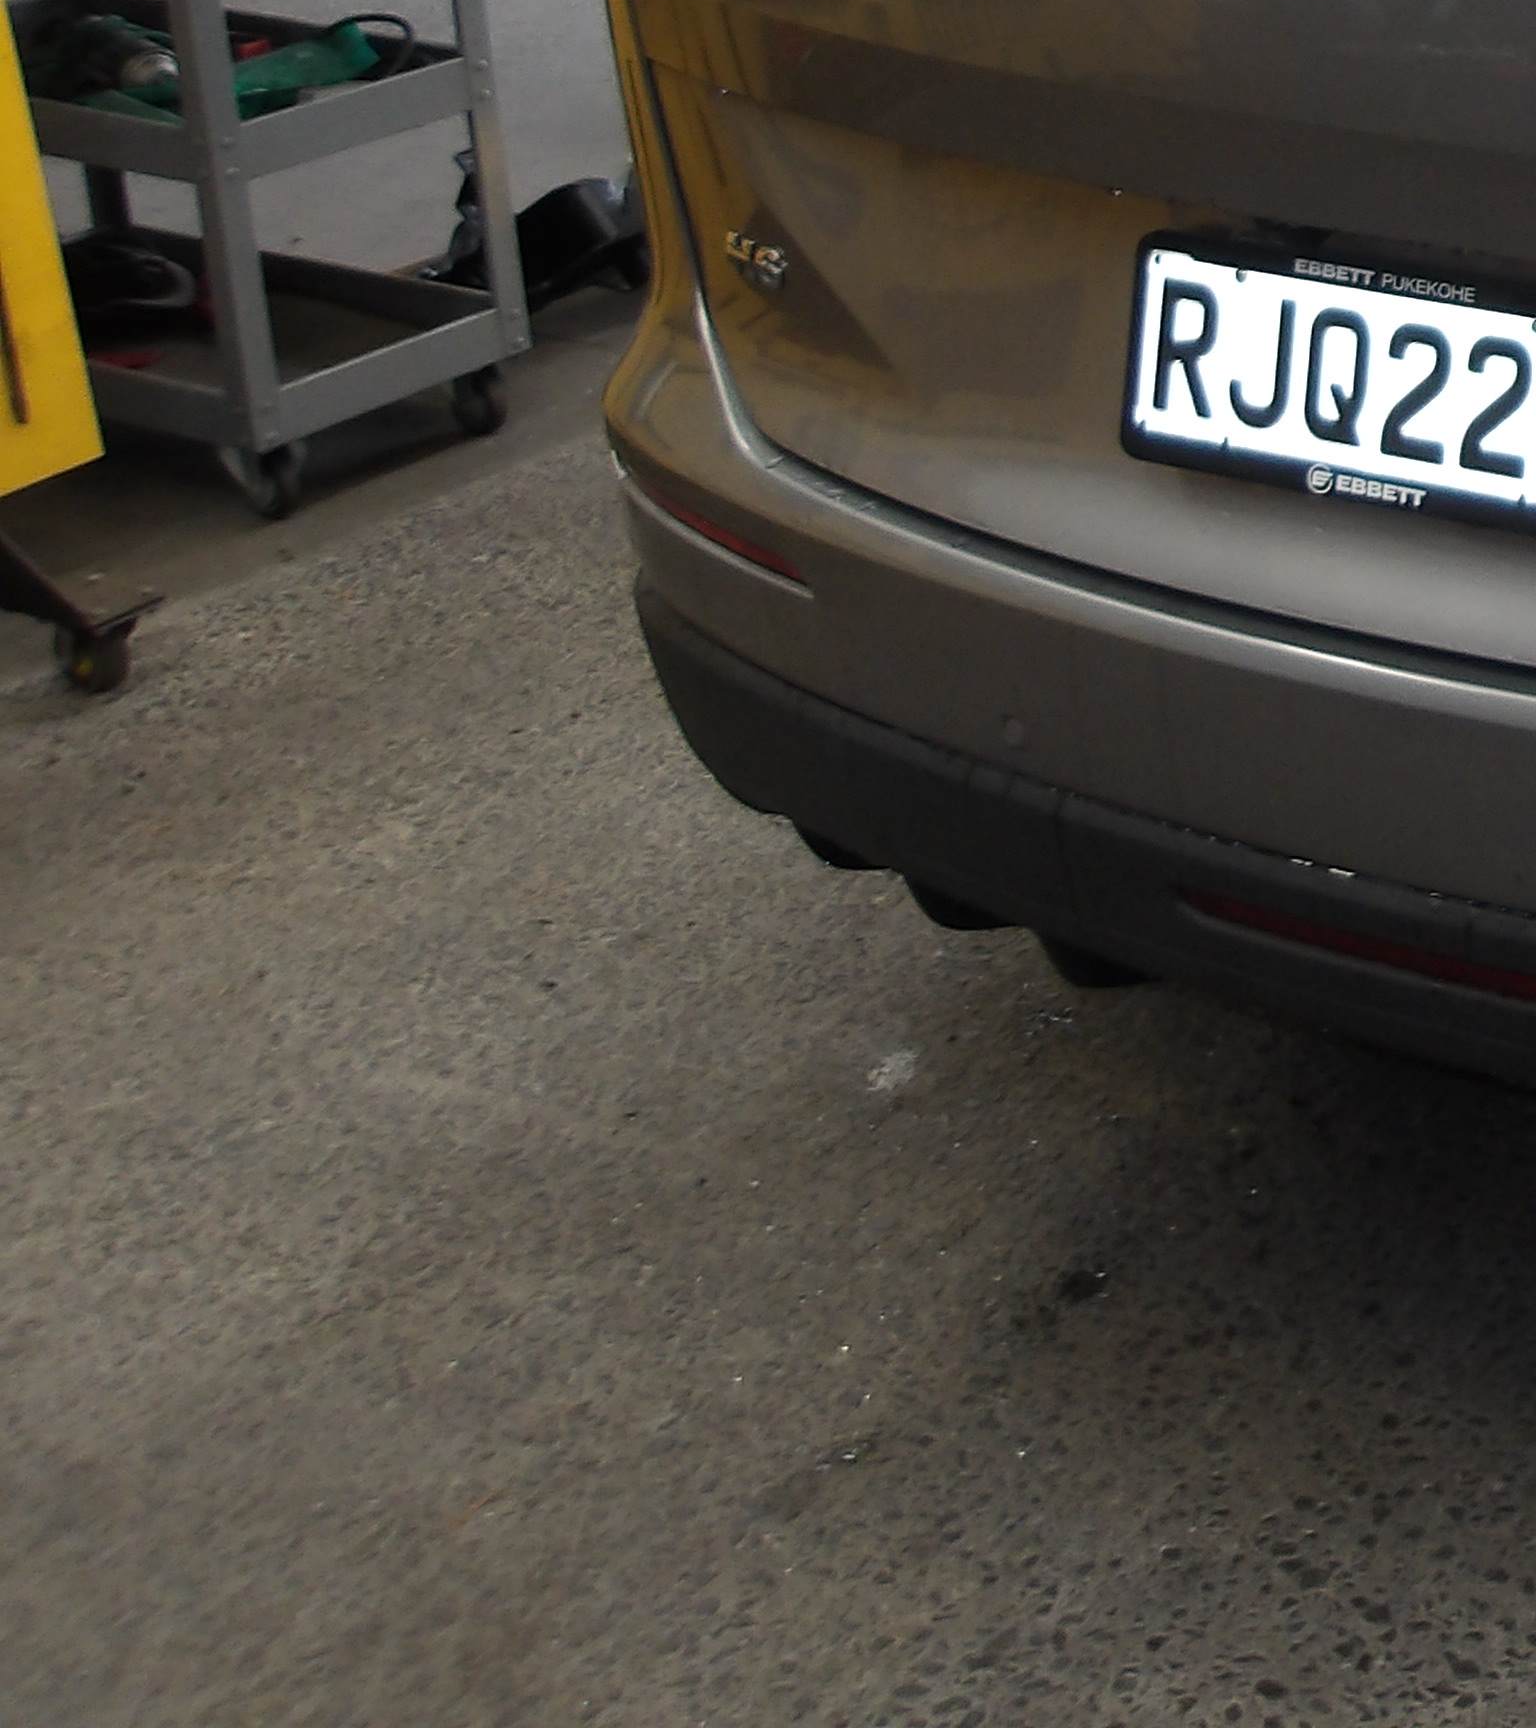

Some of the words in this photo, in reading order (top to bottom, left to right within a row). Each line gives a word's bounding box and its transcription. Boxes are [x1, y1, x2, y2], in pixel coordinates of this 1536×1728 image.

[1294, 257, 1376, 286] EBBETT
[1381, 272, 1477, 303] PUKEKOHE
[1335, 474, 1427, 507] EBBETT
